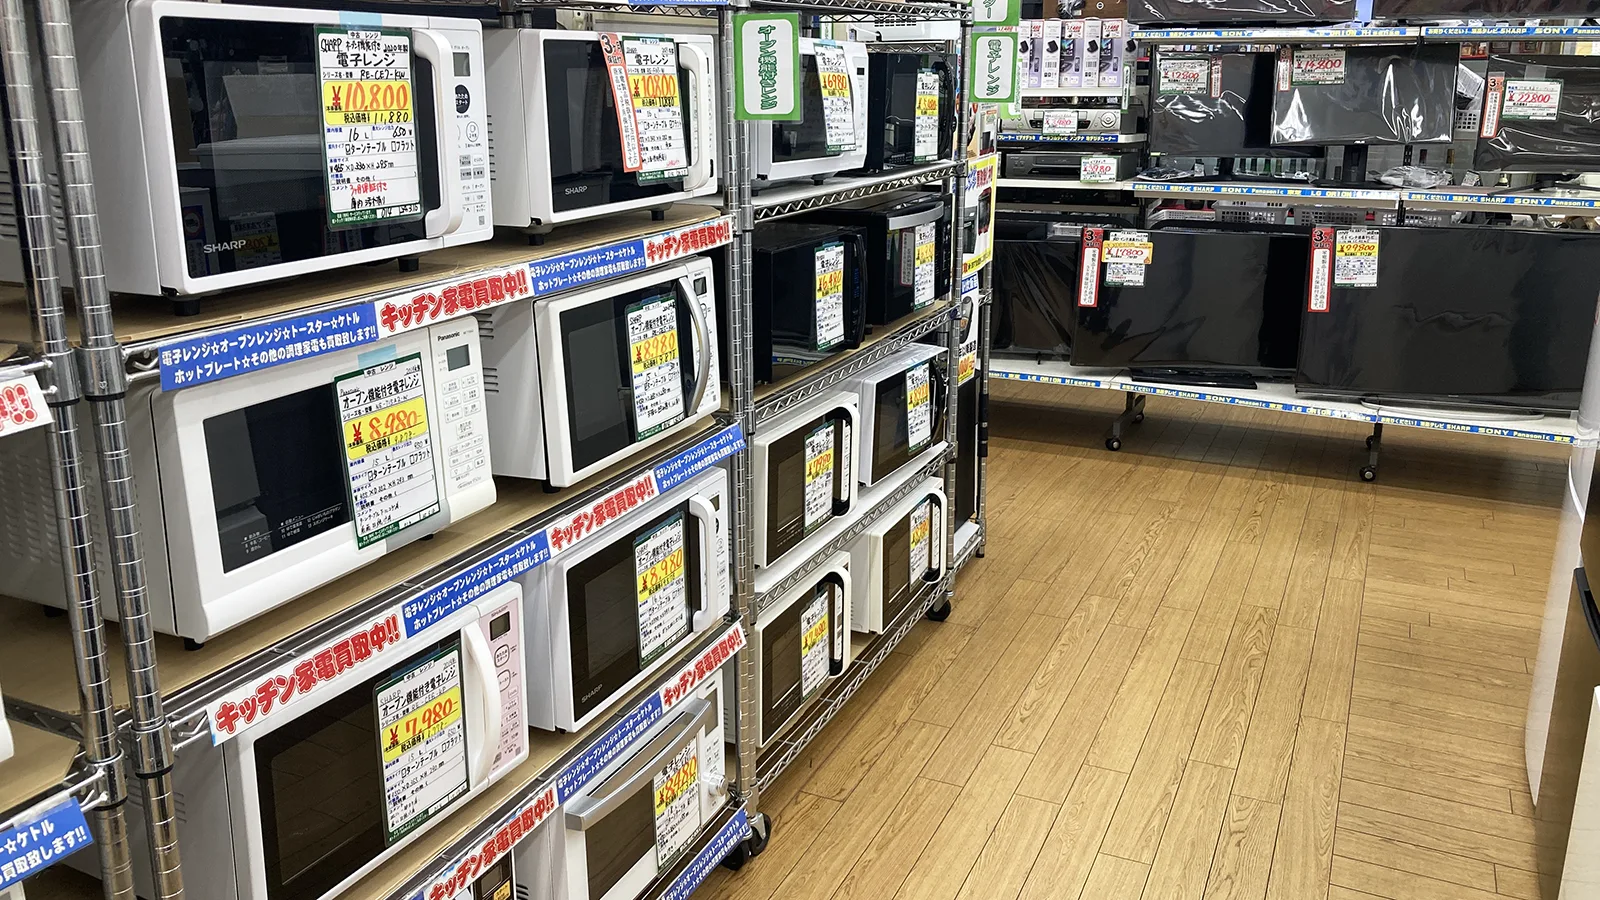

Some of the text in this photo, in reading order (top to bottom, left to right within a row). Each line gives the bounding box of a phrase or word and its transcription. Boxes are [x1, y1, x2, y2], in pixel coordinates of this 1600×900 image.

[336, 52, 396, 67] 電子レンジ
[634, 54, 668, 66] 電子レンジ
[986, 40, 1002, 96] 電子レンジ
[564, 186, 588, 195] SHARP
[203, 239, 247, 254] SHARP
[646, 221, 730, 262] キッチン家電買取中!!
[380, 268, 528, 332] キッチン家電買取中!!
[438, 331, 460, 342] Panasonic
[343, 374, 419, 408] オーブン機能付き電子レンジ
[1178, 390, 1200, 399] SHARP
[1204, 393, 1231, 403] SONY
[1446, 423, 1471, 432] SHARP
[1478, 426, 1509, 436] SONY
[1513, 430, 1550, 441] Panasonic
[550, 474, 655, 550] キッチン家電買取中!!
[215, 614, 401, 734] キッチン家電買取中!!
[382, 664, 456, 717] オーブン機能付き電子レンジ
[581, 684, 603, 703] SHARP
